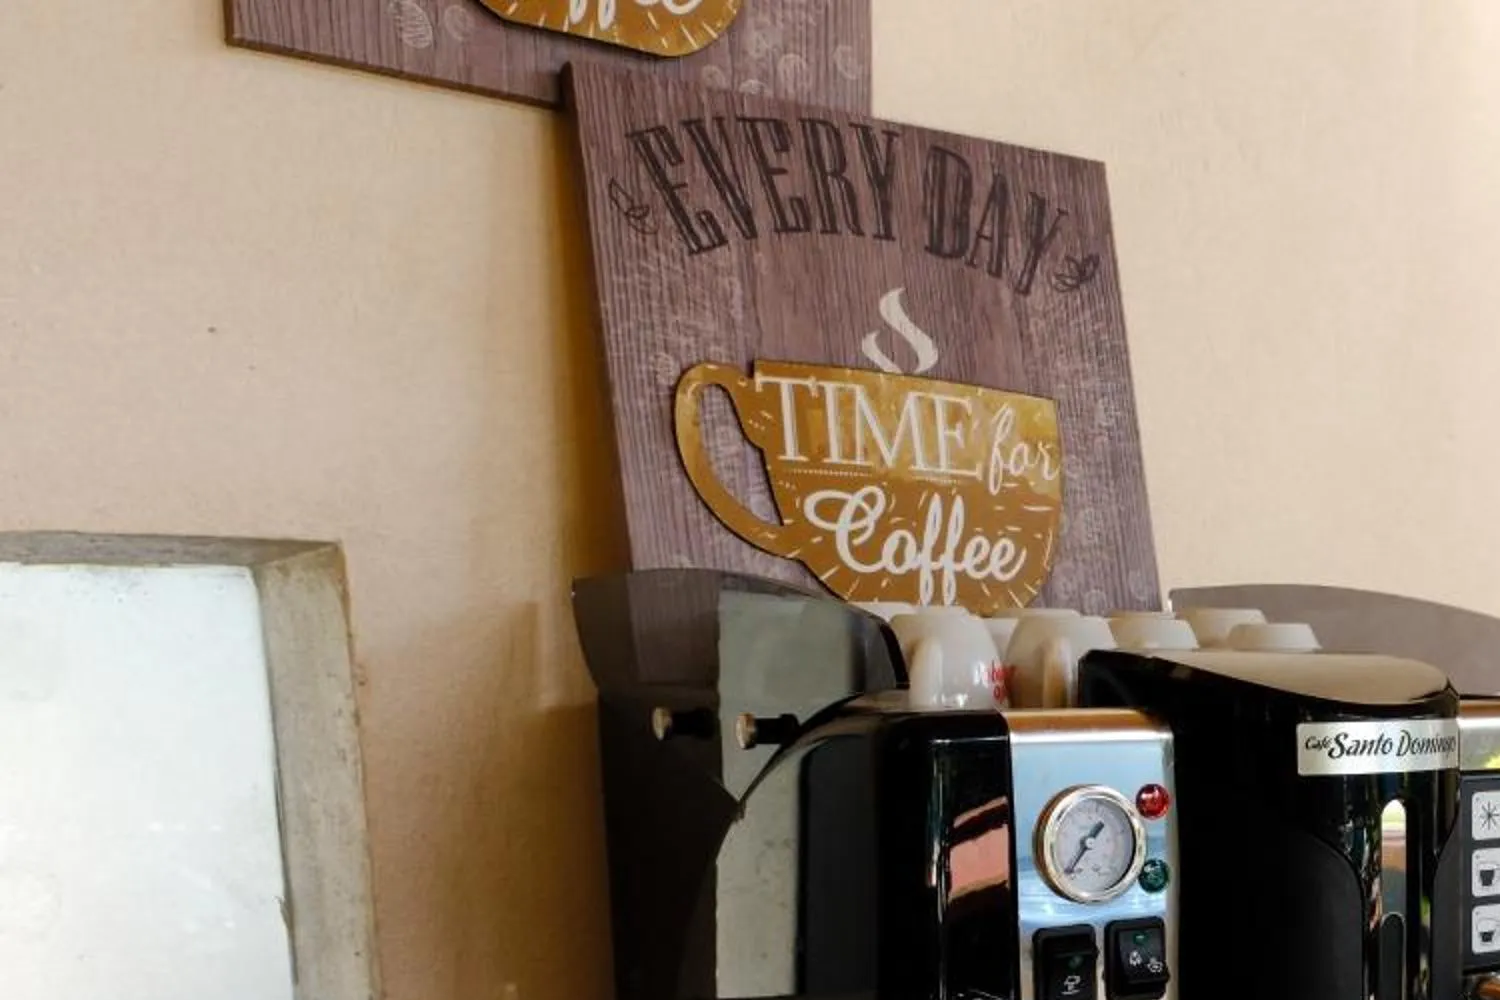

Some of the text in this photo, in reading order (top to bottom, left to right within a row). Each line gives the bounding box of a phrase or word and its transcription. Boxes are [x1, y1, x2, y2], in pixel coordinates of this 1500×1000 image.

[625, 115, 1069, 296] EVERY DAY
[755, 373, 1061, 496] TIME for
[803, 484, 1027, 606] Coffee
[1327, 731, 1394, 760] Santo
